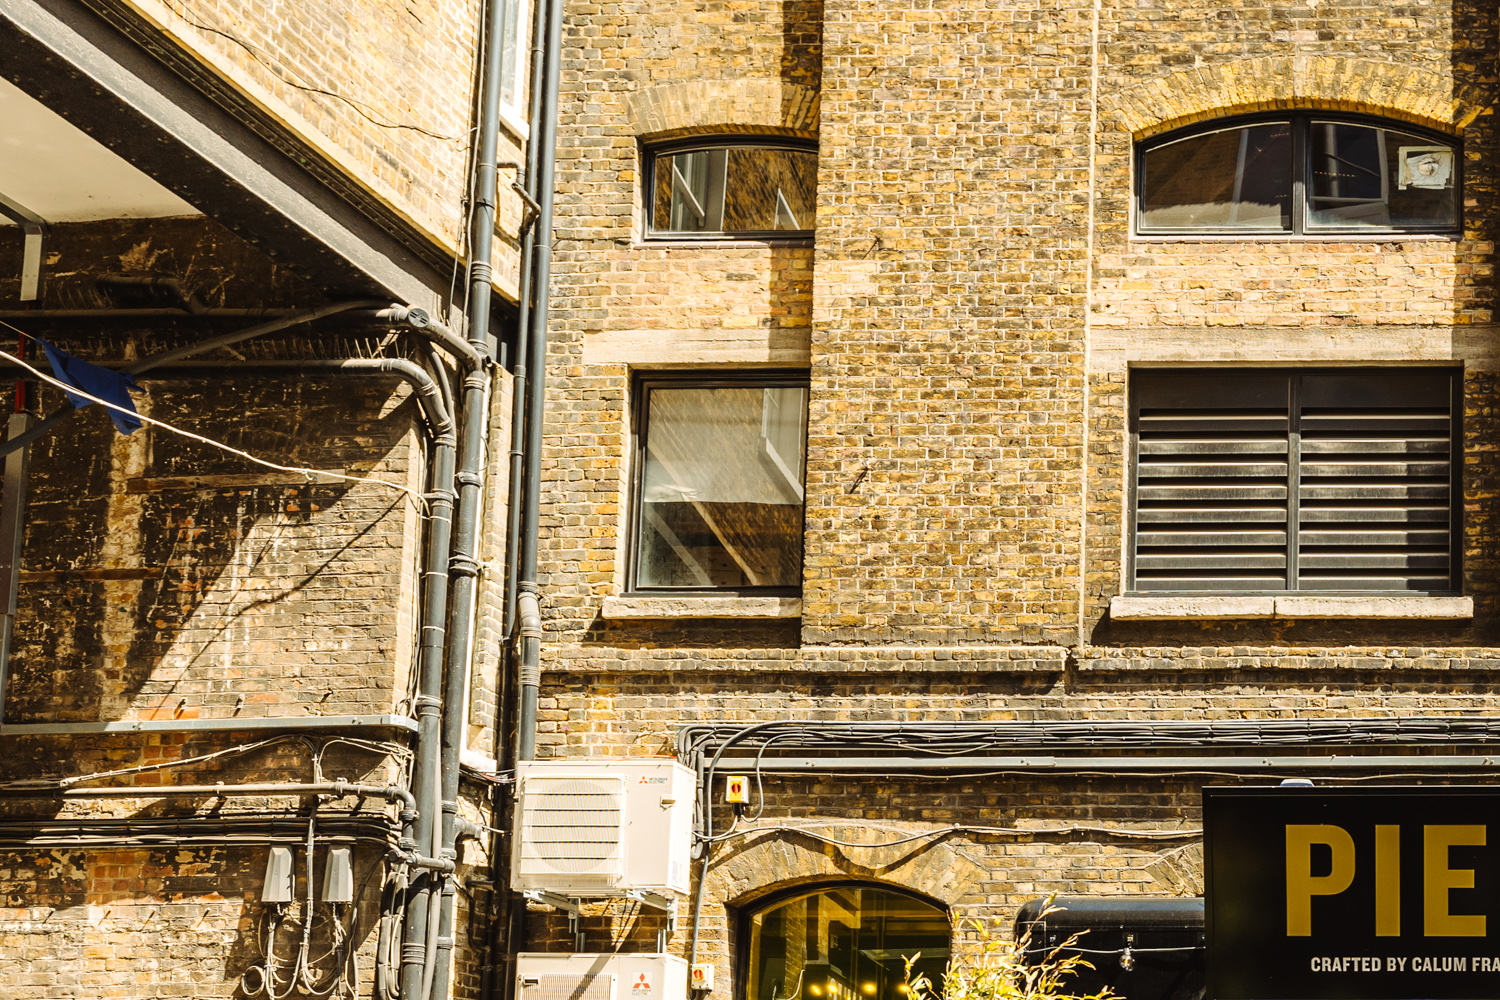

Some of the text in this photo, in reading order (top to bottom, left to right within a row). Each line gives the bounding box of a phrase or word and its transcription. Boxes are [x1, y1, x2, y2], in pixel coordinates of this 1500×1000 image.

[1310, 957, 1382, 972] CRAFTED
[1387, 957, 1407, 972] BY
[1411, 957, 1467, 972] CALUM
